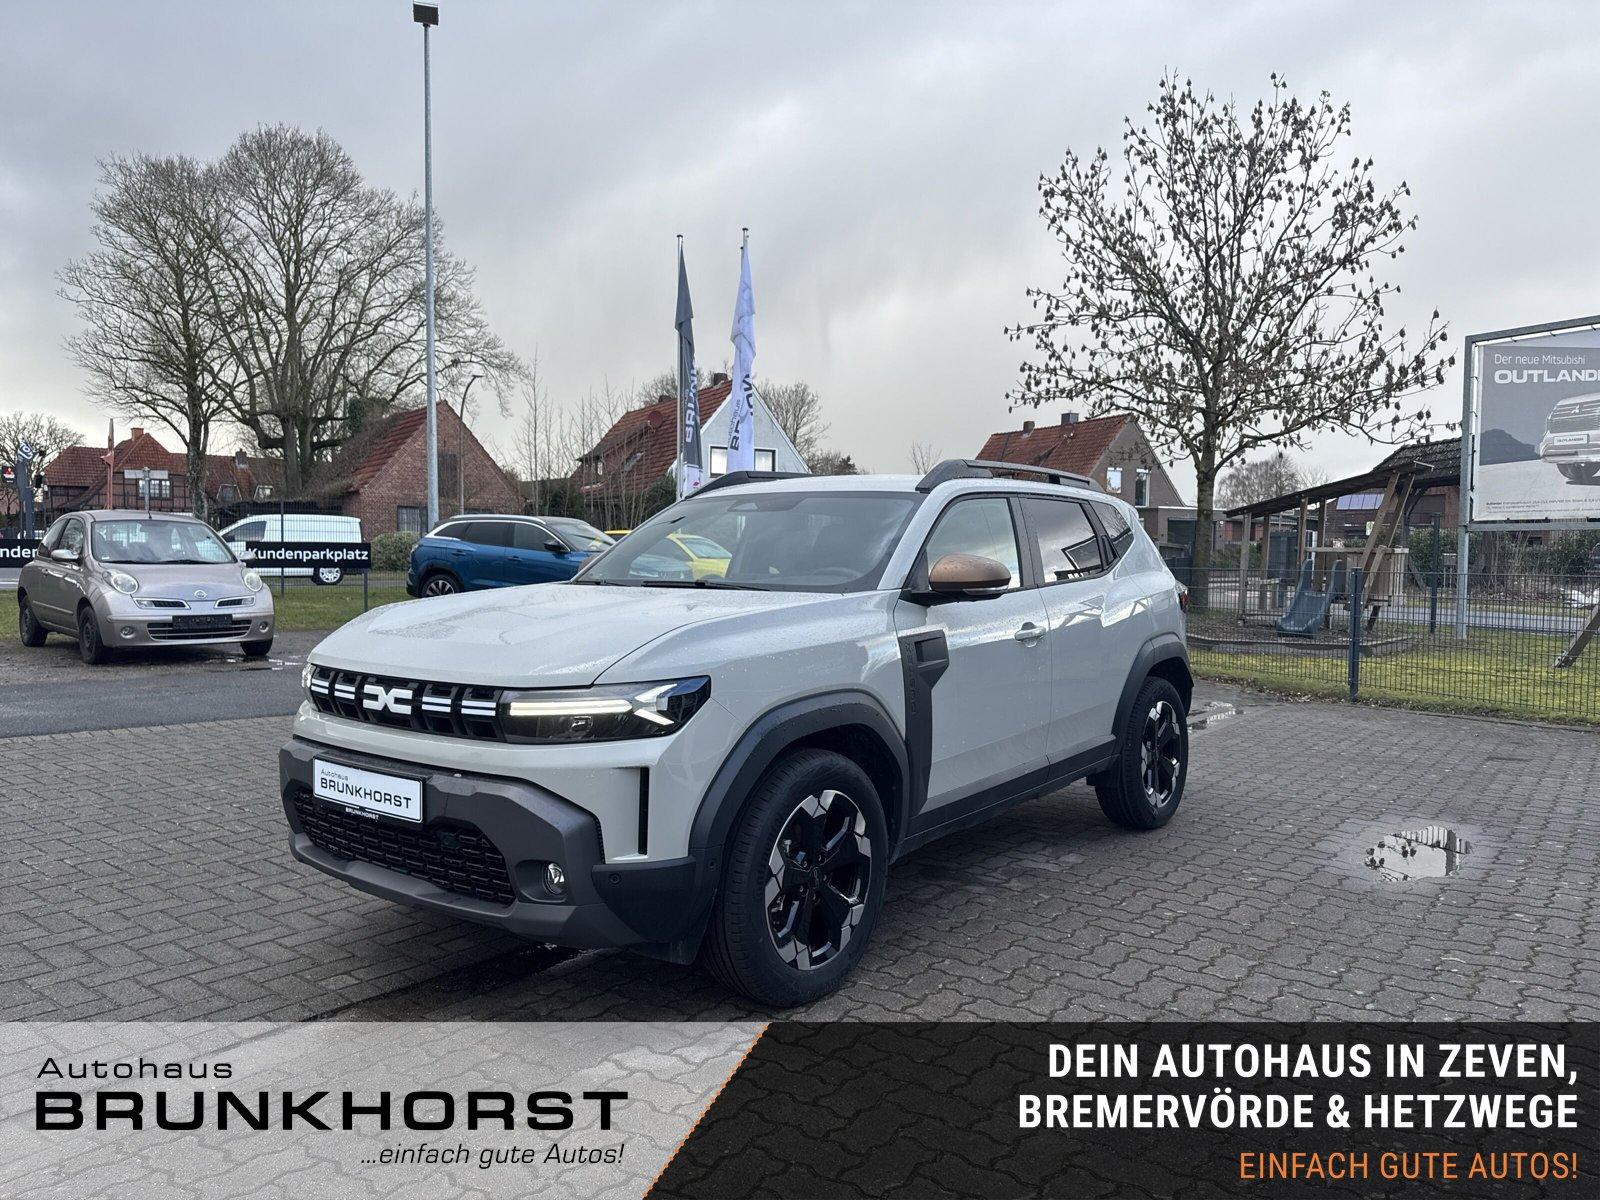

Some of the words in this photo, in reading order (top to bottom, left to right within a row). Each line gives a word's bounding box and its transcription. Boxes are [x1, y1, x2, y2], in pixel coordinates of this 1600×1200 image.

[1494, 353, 1513, 365] Der
[1515, 355, 1540, 365] neue
[1542, 354, 1587, 365] Mitsubishi
[1494, 369, 1600, 384] OUTLAND
[321, 768, 348, 781] Autohaus
[320, 778, 412, 809] BRUNKHORST
